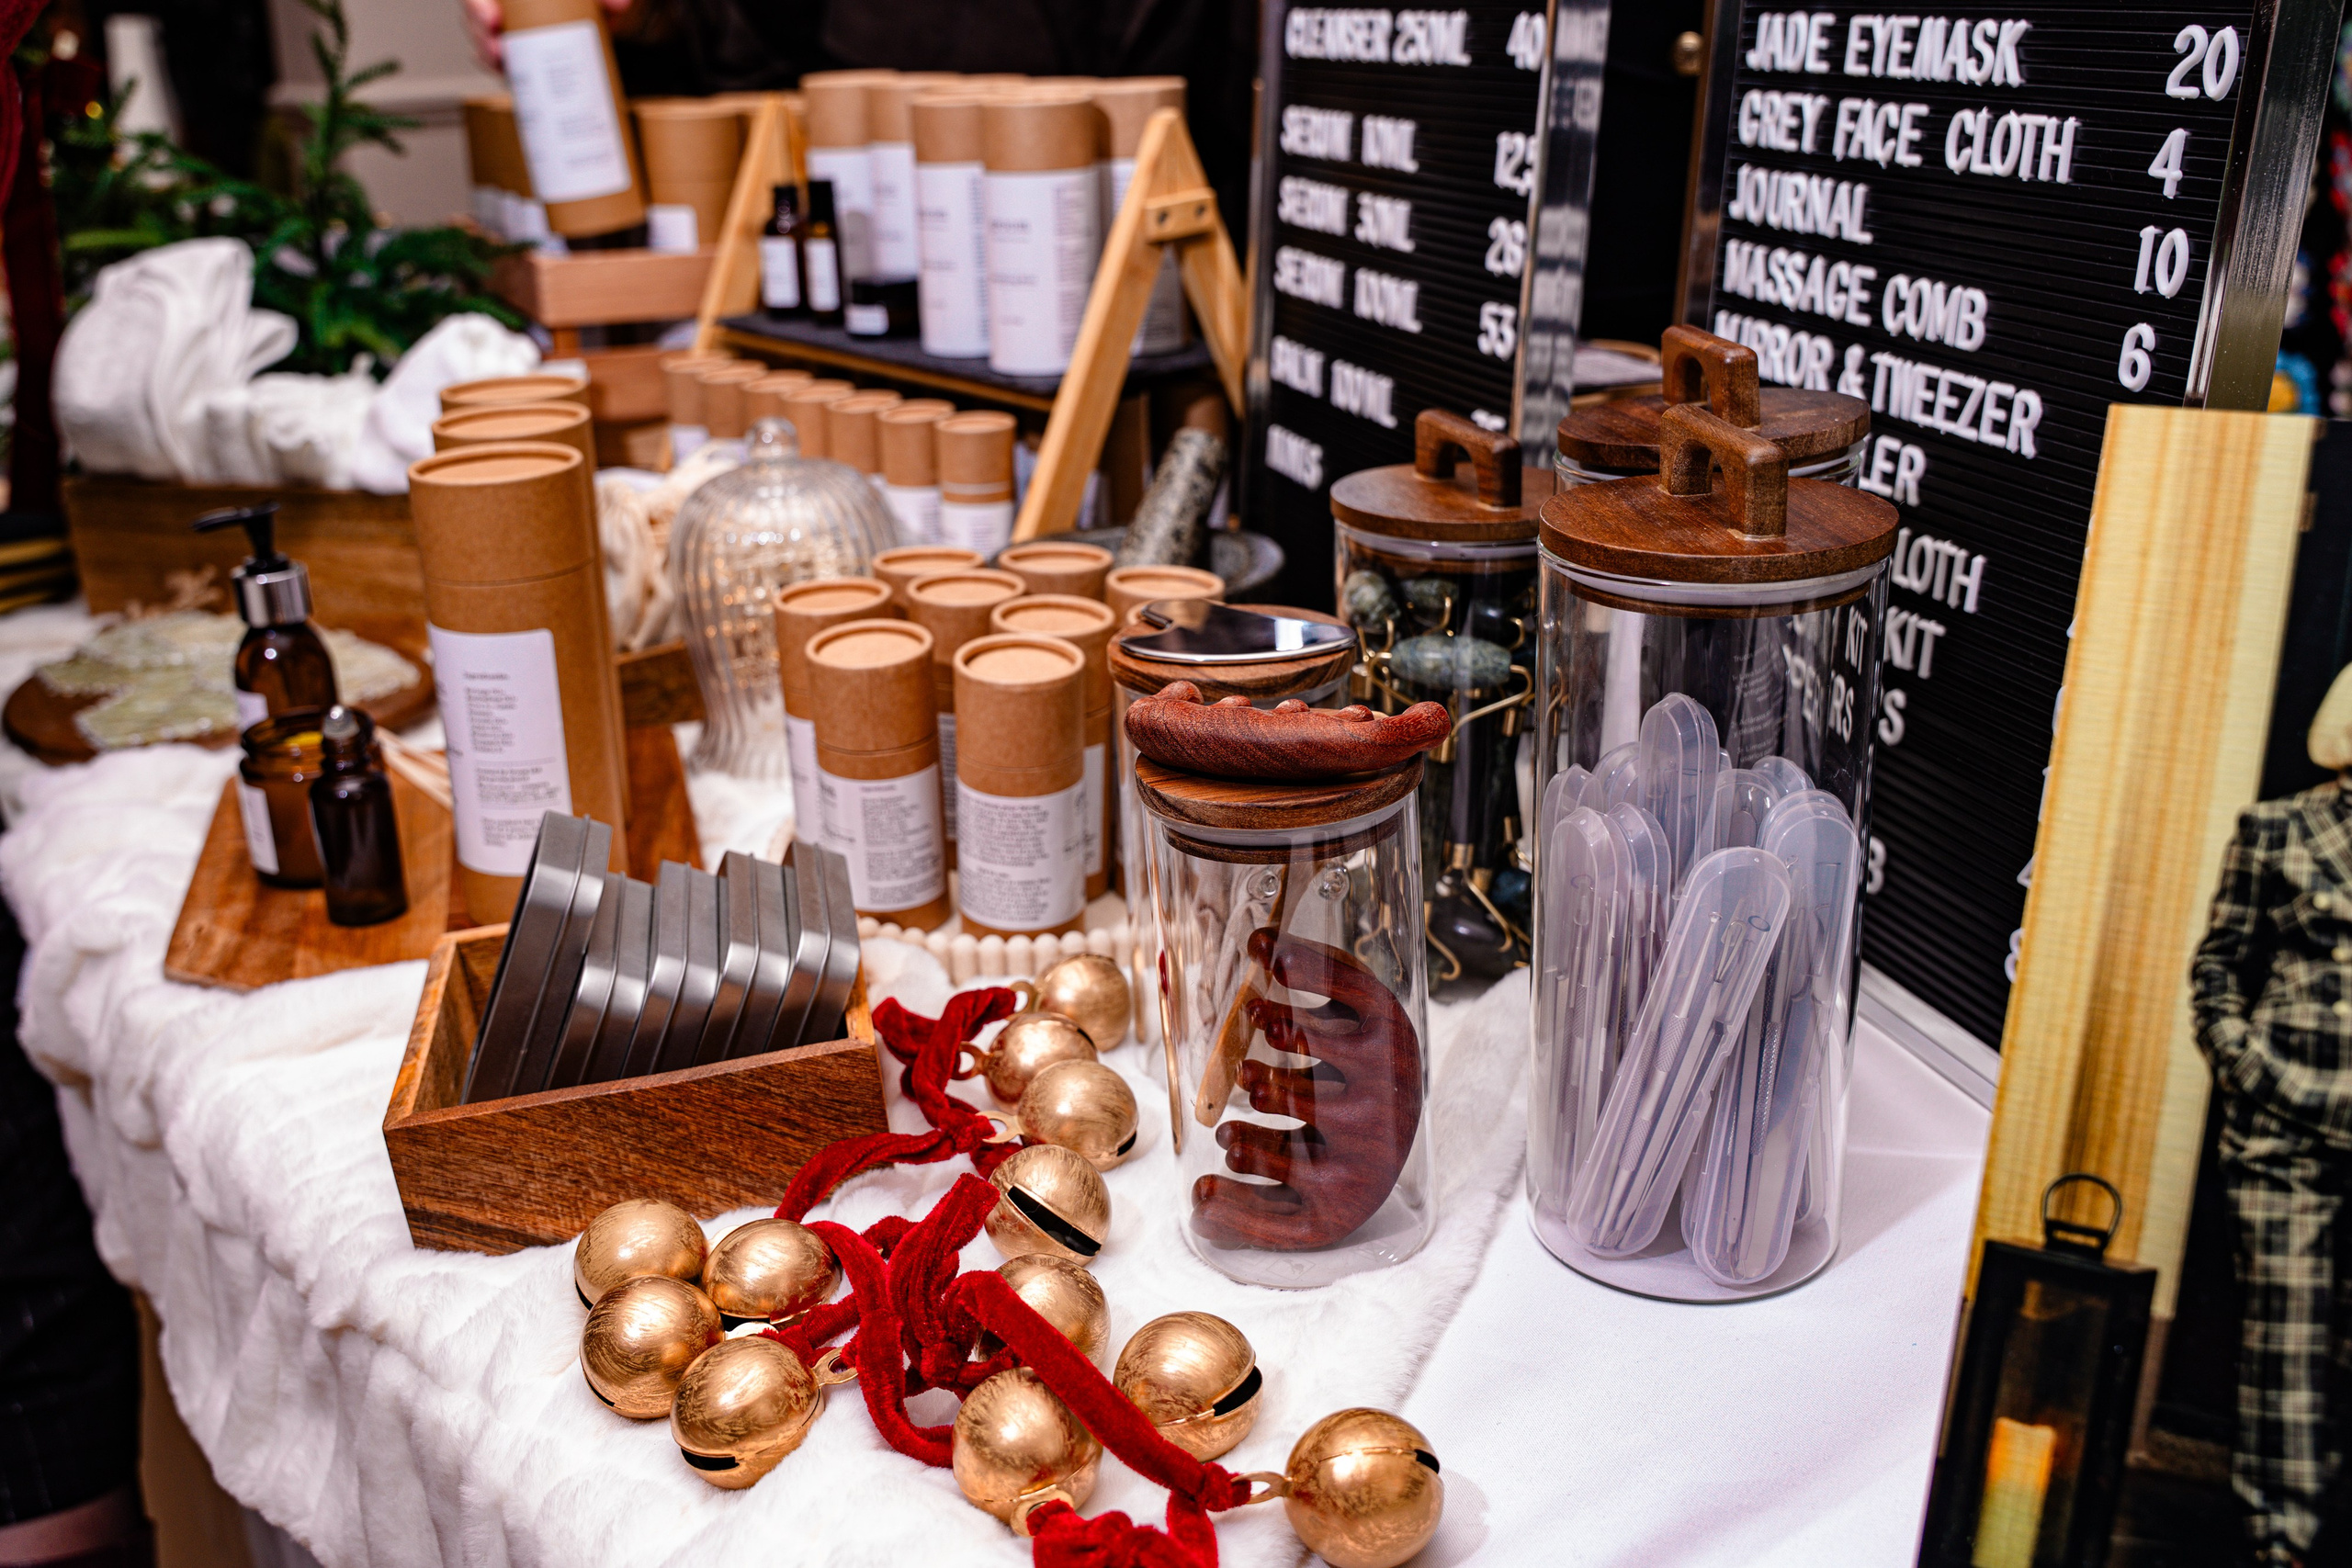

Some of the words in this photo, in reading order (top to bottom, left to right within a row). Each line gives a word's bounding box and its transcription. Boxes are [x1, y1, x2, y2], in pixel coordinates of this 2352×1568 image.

[1507, 11, 1545, 72] 40
[1747, 12, 1836, 73] JADE
[1844, 15, 2031, 87] EYEMASK
[2165, 25, 2239, 101] 20
[1738, 90, 1828, 153] GREY
[1833, 98, 1929, 167] FACE
[1945, 107, 2080, 184] CLOTH
[2148, 129, 2188, 198] 4
[1727, 164, 1872, 245] JOURNAL
[2134, 225, 2188, 299] 10
[1722, 237, 1876, 328] MASSAGE
[1882, 274, 1987, 352] COMB
[2119, 323, 2155, 391] 6
[1871, 352, 2043, 458] TWEEZER
[1884, 605, 1946, 679] KIT
